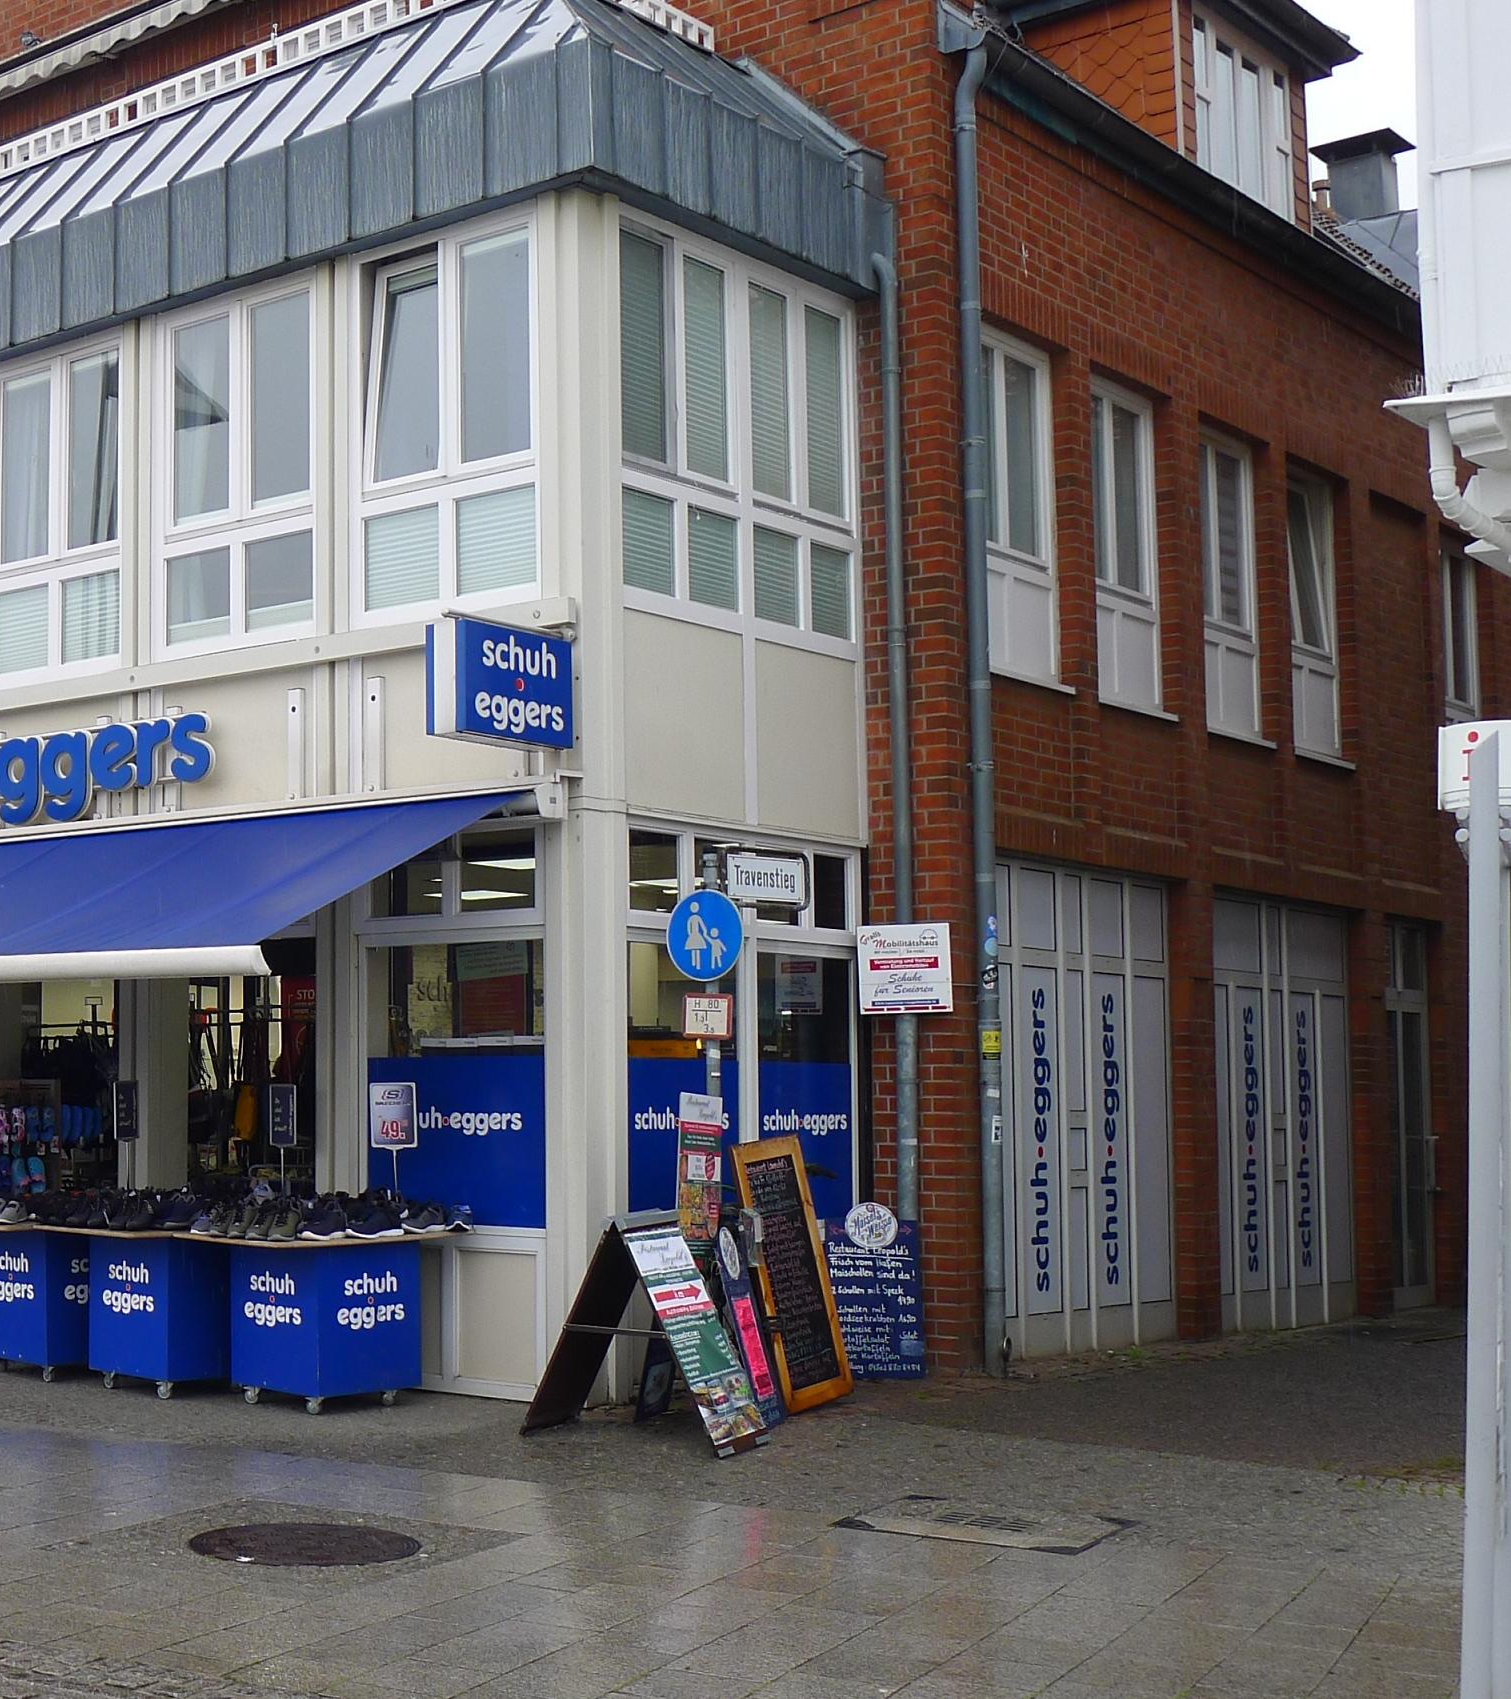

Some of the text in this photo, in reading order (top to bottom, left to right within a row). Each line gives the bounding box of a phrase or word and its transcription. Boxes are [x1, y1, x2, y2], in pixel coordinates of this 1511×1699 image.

[482, 635, 557, 680] schuh
[475, 691, 565, 734] eggers
[734, 864, 796, 893] Travenstieg
[873, 939, 938, 949] Mobilitätshaus
[888, 972, 922, 983] Schuhe
[893, 984, 934, 994] Senioren
[694, 1000, 719, 1009] H 80
[1031, 988, 1051, 1292] schuh eggers
[1101, 994, 1119, 1285] schuh eggers
[1243, 1006, 1258, 1272] schuh eggers
[1296, 1010, 1312, 1267] schuh eggers
[828, 1242, 909, 1257] Restaurant Leopold's
[108, 1260, 149, 1284] schuh
[830, 1258, 854, 1266] Frisch
[876, 1258, 903, 1269] Hafen
[830, 1267, 874, 1278] Maischollen
[876, 1269, 895, 1279] sind
[250, 1271, 295, 1295] schuh
[344, 1270, 398, 1296] schuh
[838, 1285, 865, 1294] Schollen
[868, 1283, 881, 1294] mit
[882, 1283, 905, 1296] Speck
[102, 1289, 154, 1314] eggers
[837, 1303, 887, 1313] Schollen mit
[244, 1301, 301, 1327] eggers
[337, 1301, 405, 1330] eggers
[839, 1314, 895, 1323] ordseekrabben
[861, 1352, 900, 1362] Kartoffeln
